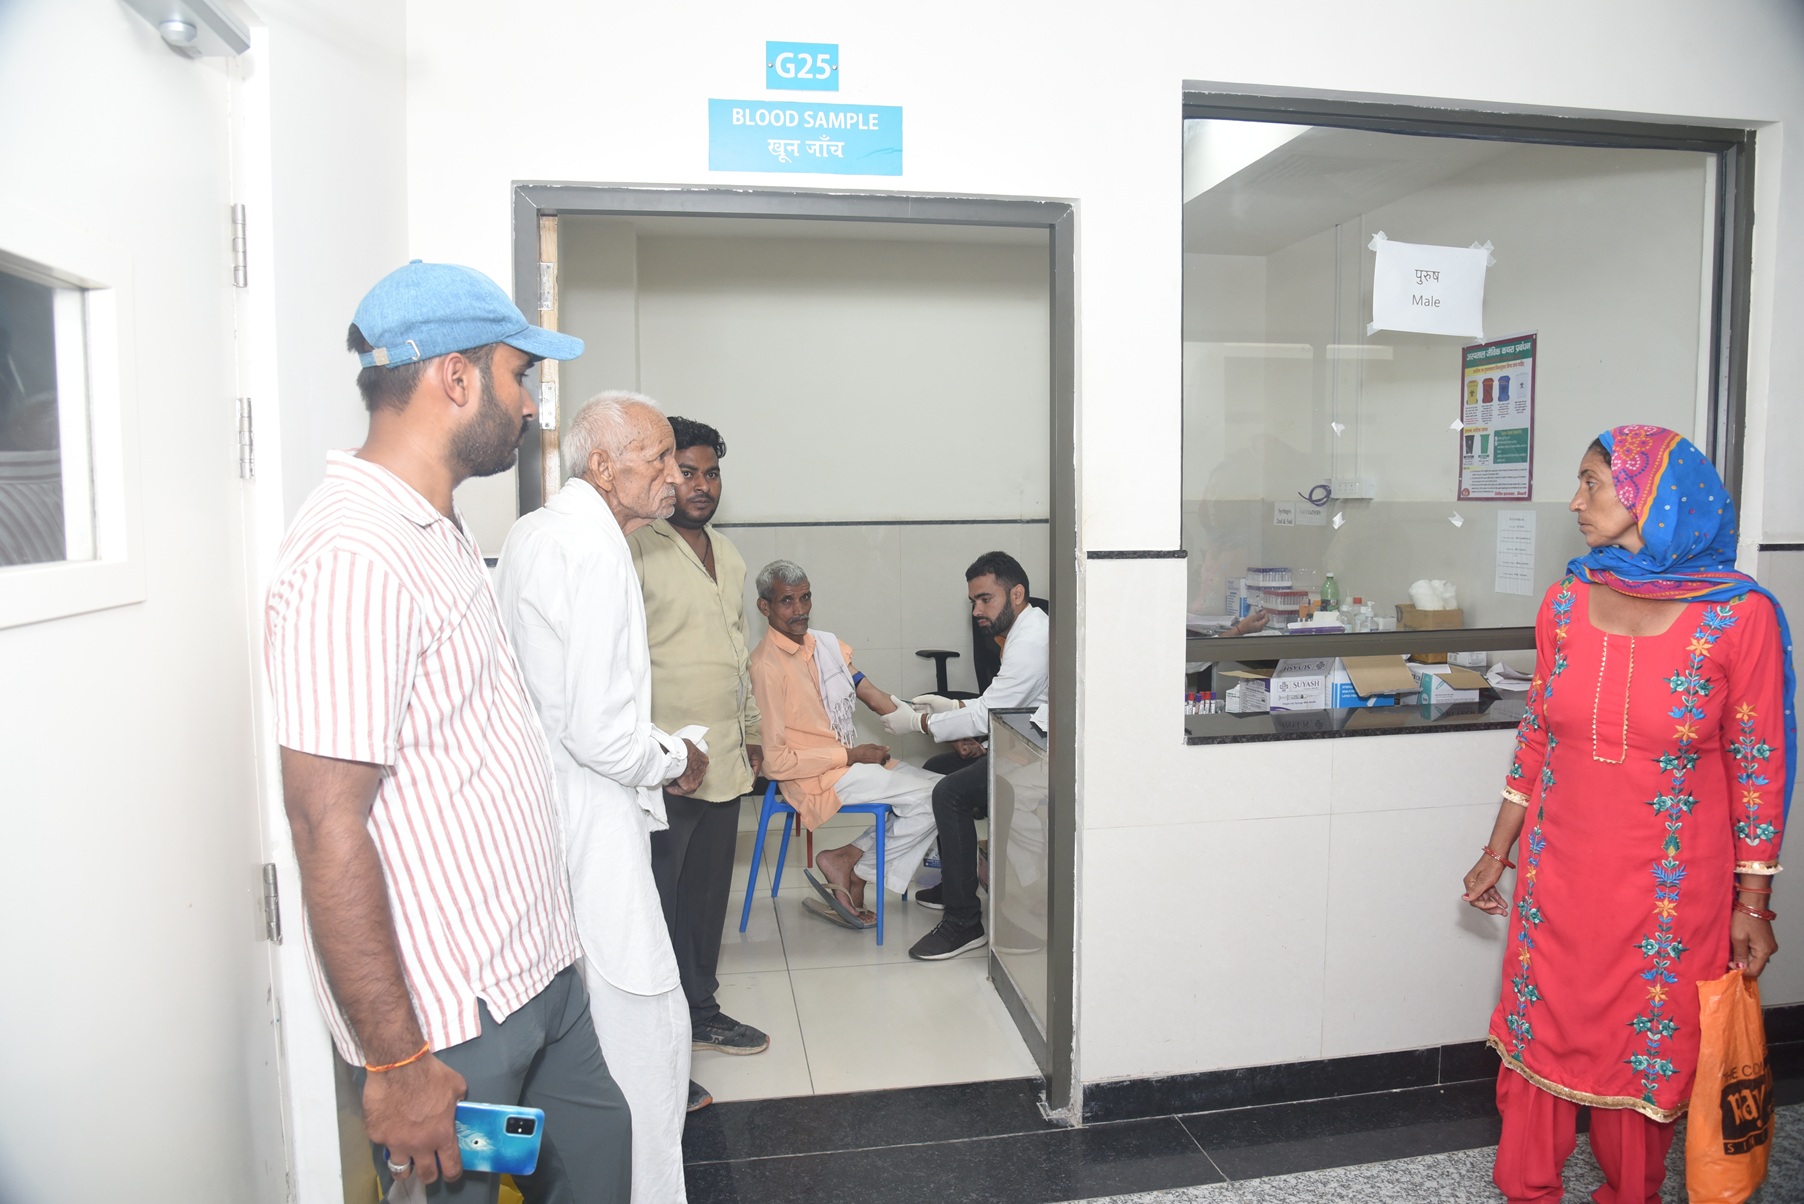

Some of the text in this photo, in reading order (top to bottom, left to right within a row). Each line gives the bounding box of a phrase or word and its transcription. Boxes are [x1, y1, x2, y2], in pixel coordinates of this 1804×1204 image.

[775, 52, 831, 79] G25
[732, 108, 879, 130] BLOOD SAMPLE
[767, 134, 845, 163] खून जाँच
[1415, 269, 1440, 285] पुरुष
[1412, 294, 1440, 307] Male
[1292, 679, 1320, 689] SUYASH
